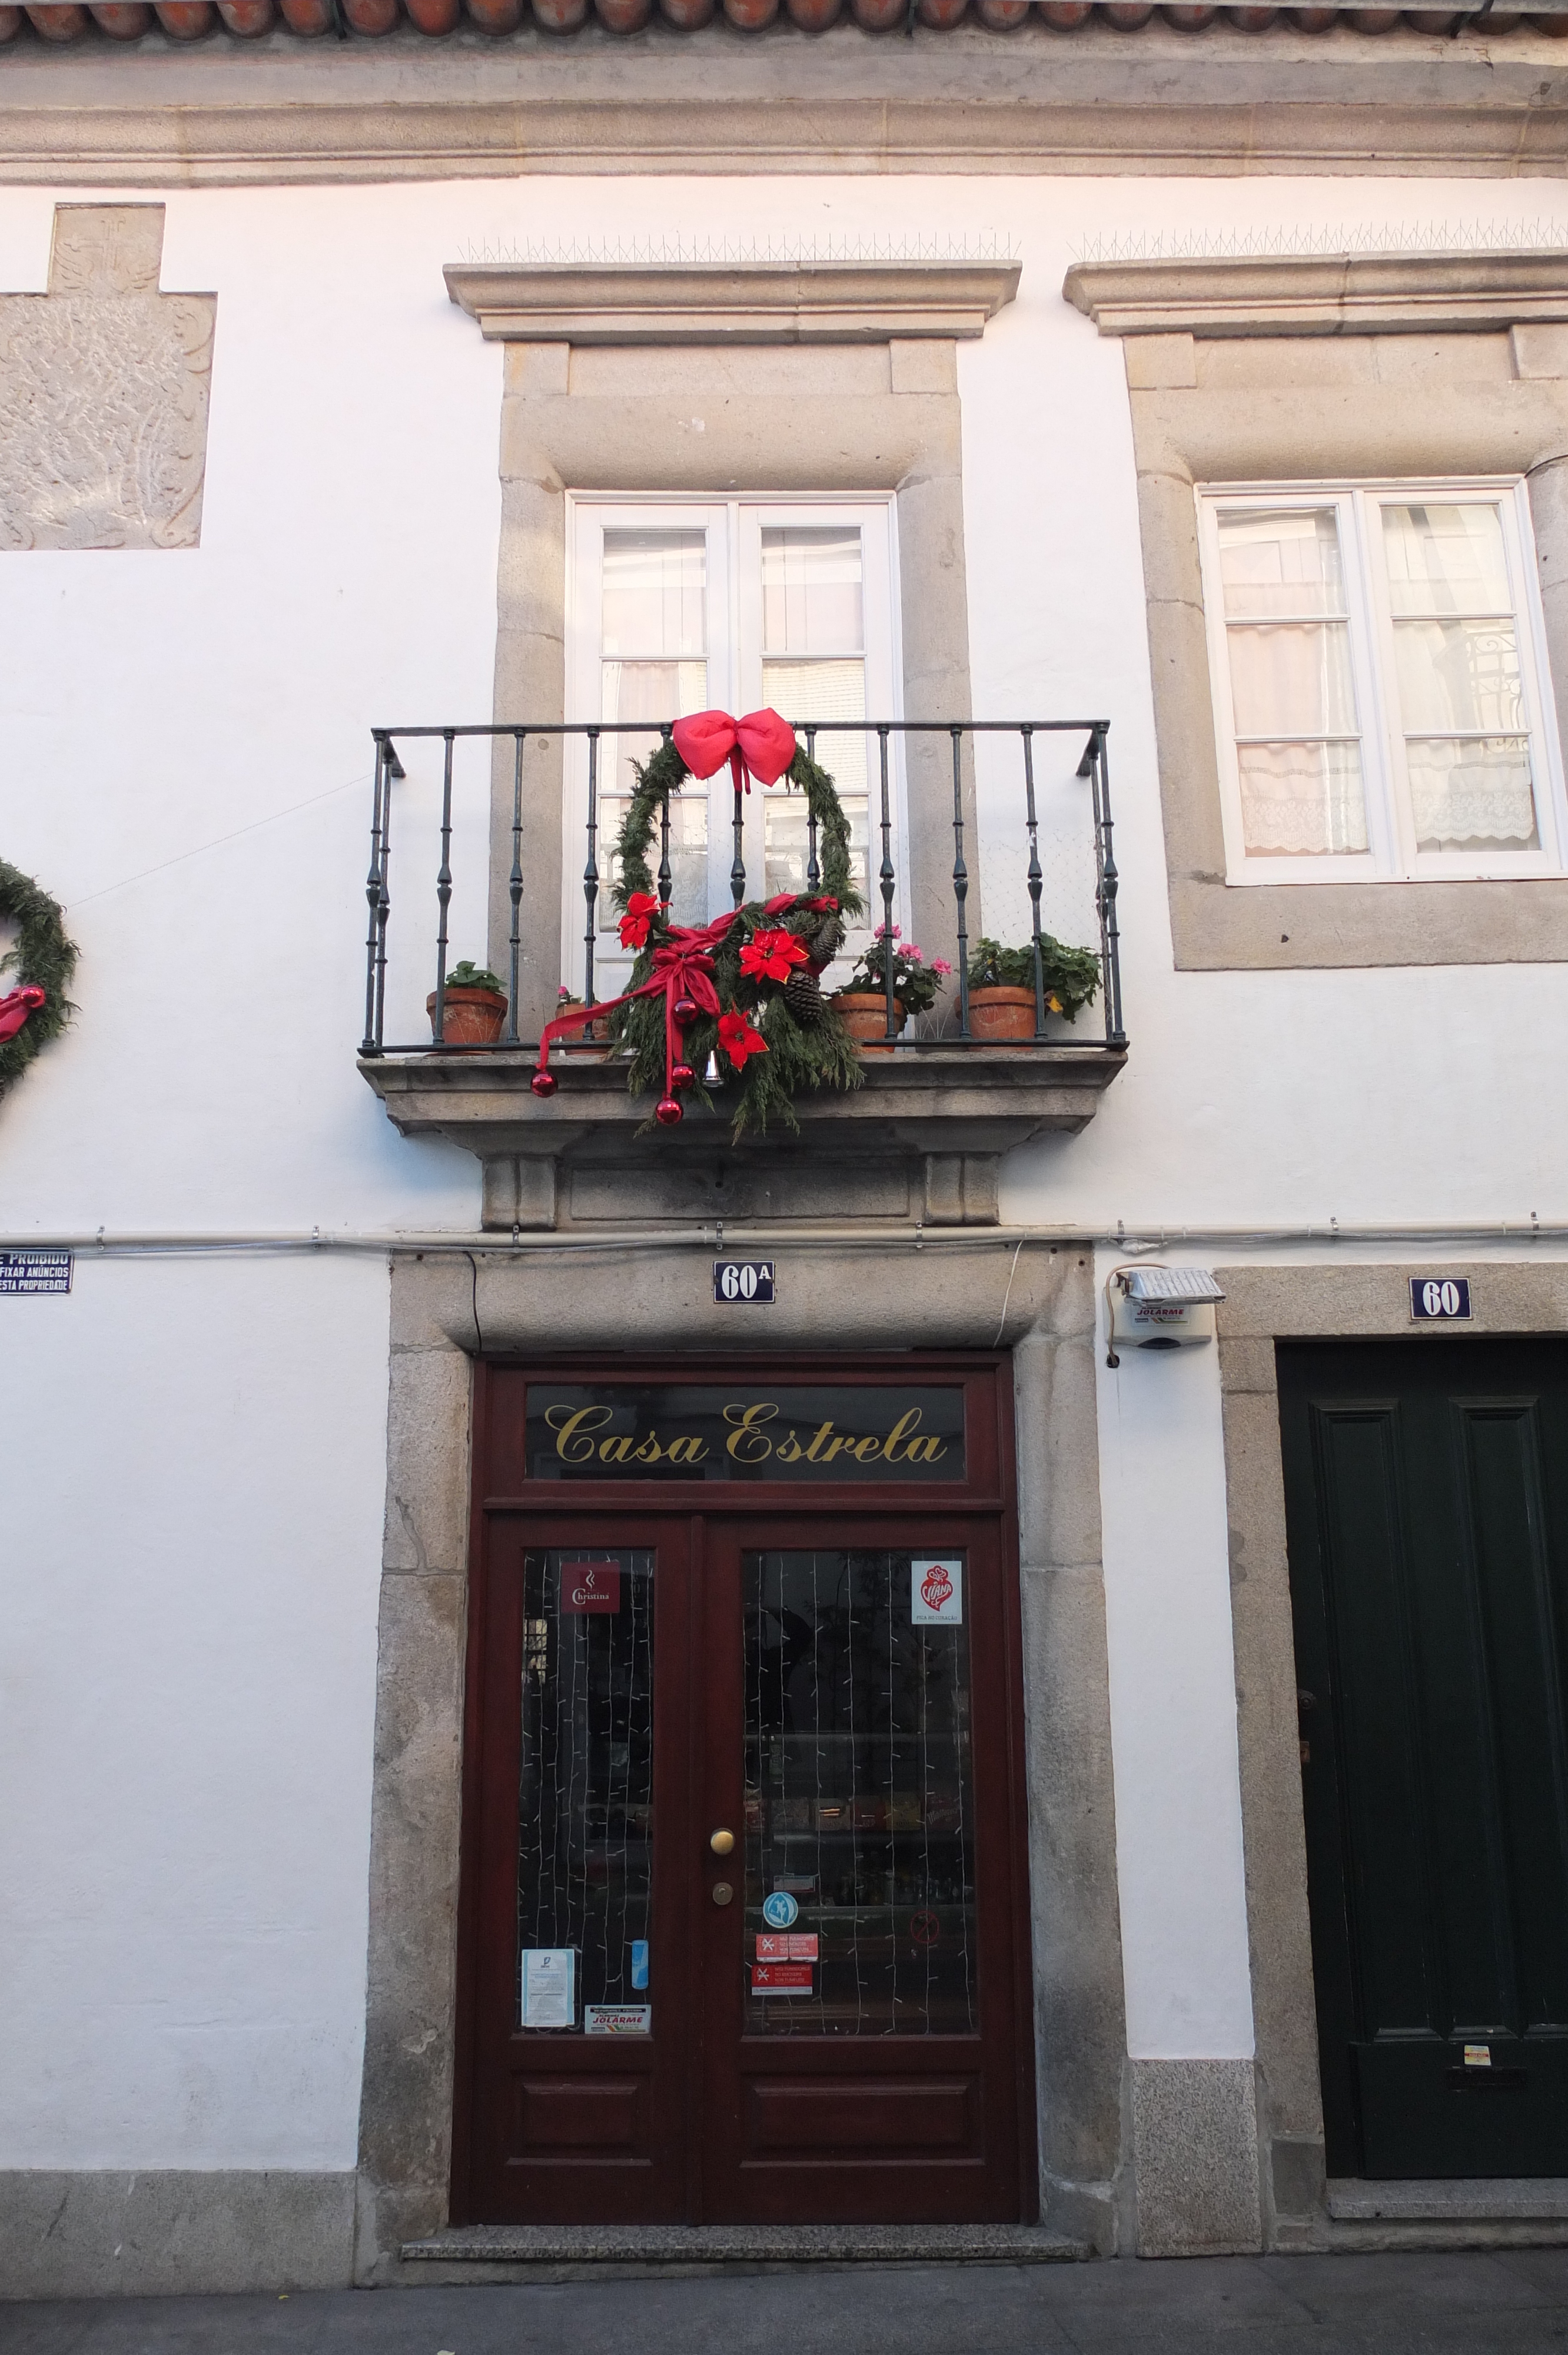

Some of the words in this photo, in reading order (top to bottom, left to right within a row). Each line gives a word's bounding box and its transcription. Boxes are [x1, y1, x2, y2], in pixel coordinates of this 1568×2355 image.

[9, 1254, 69, 1265] PROIBIDO
[26, 1265, 69, 1278] ANÚNCIOS
[18, 1280, 68, 1291] PROPRIEDADE
[1423, 1281, 1459, 1315] 60
[545, 1404, 710, 1462] Casa
[723, 1403, 948, 1462] Estrela
[572, 1588, 610, 1605] Christina
